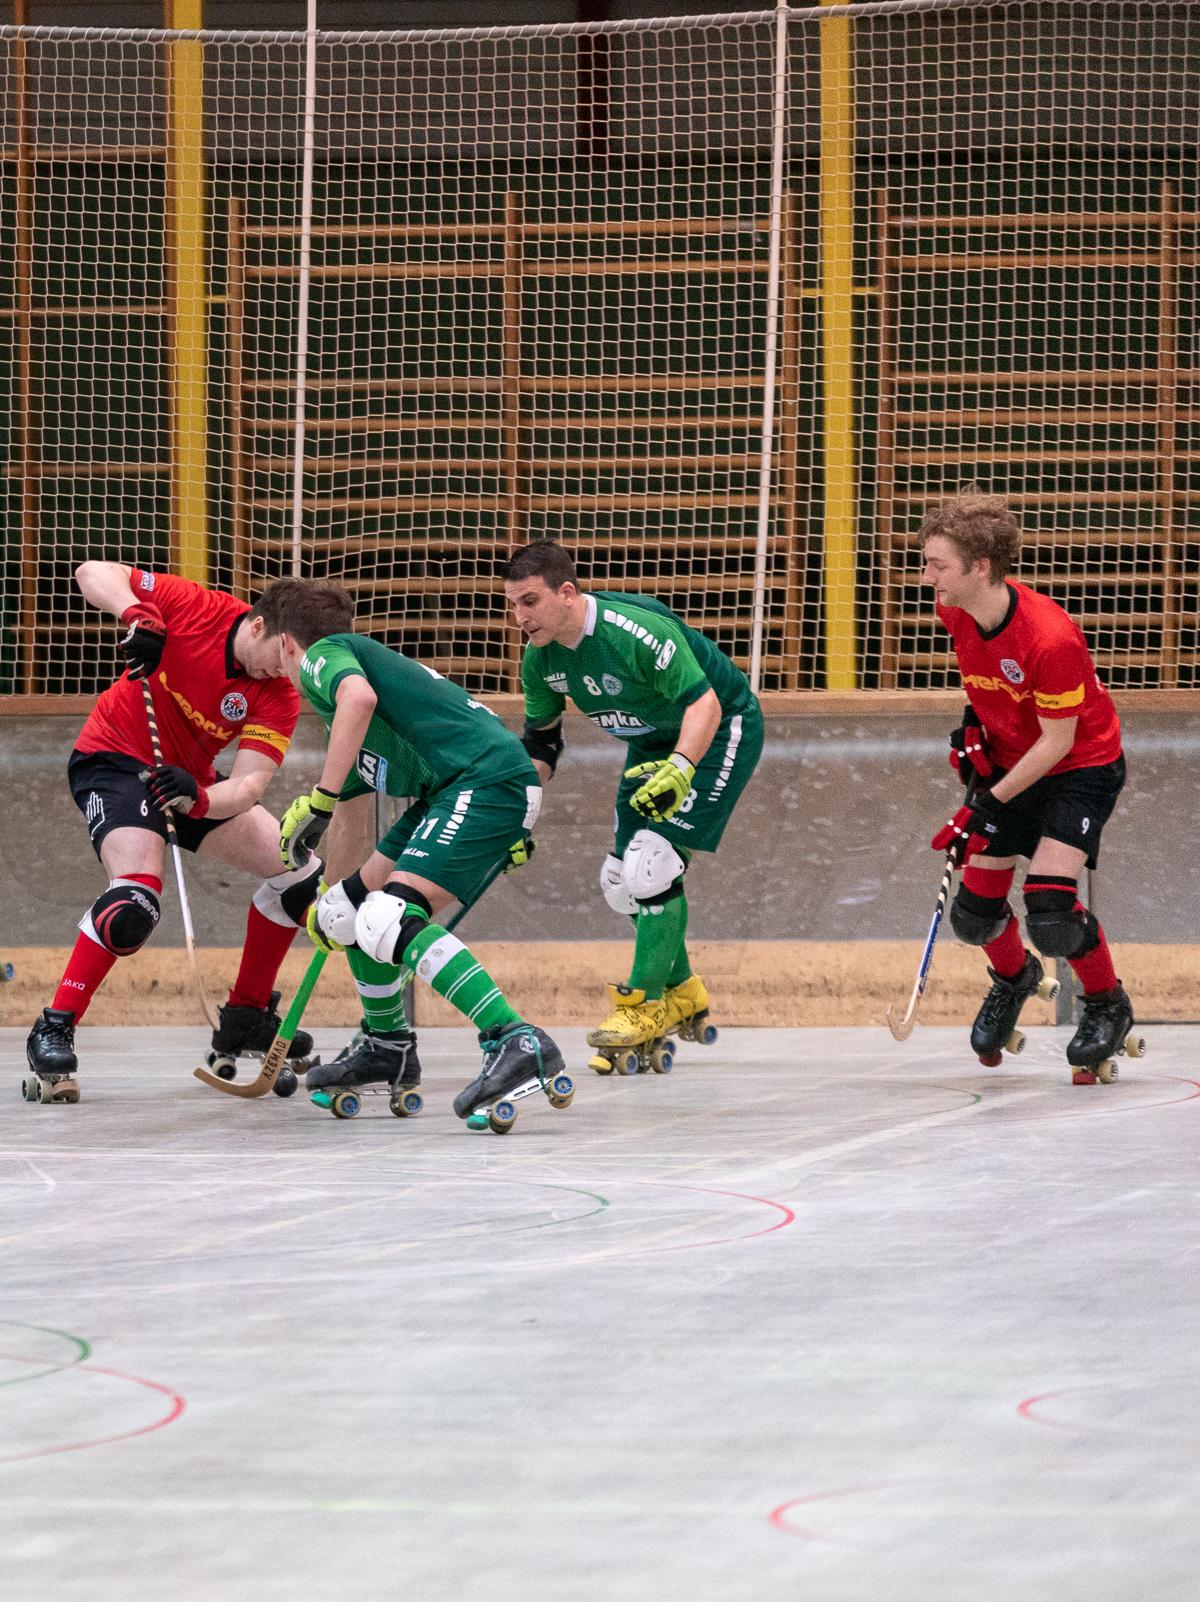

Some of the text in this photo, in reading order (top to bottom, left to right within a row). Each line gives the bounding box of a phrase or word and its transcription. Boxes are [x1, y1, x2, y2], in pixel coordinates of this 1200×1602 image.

[582, 675, 602, 696] 8
[140, 800, 148, 817] 6
[1081, 817, 1090, 835] 9
[262, 1040, 287, 1081] AZEMAD
